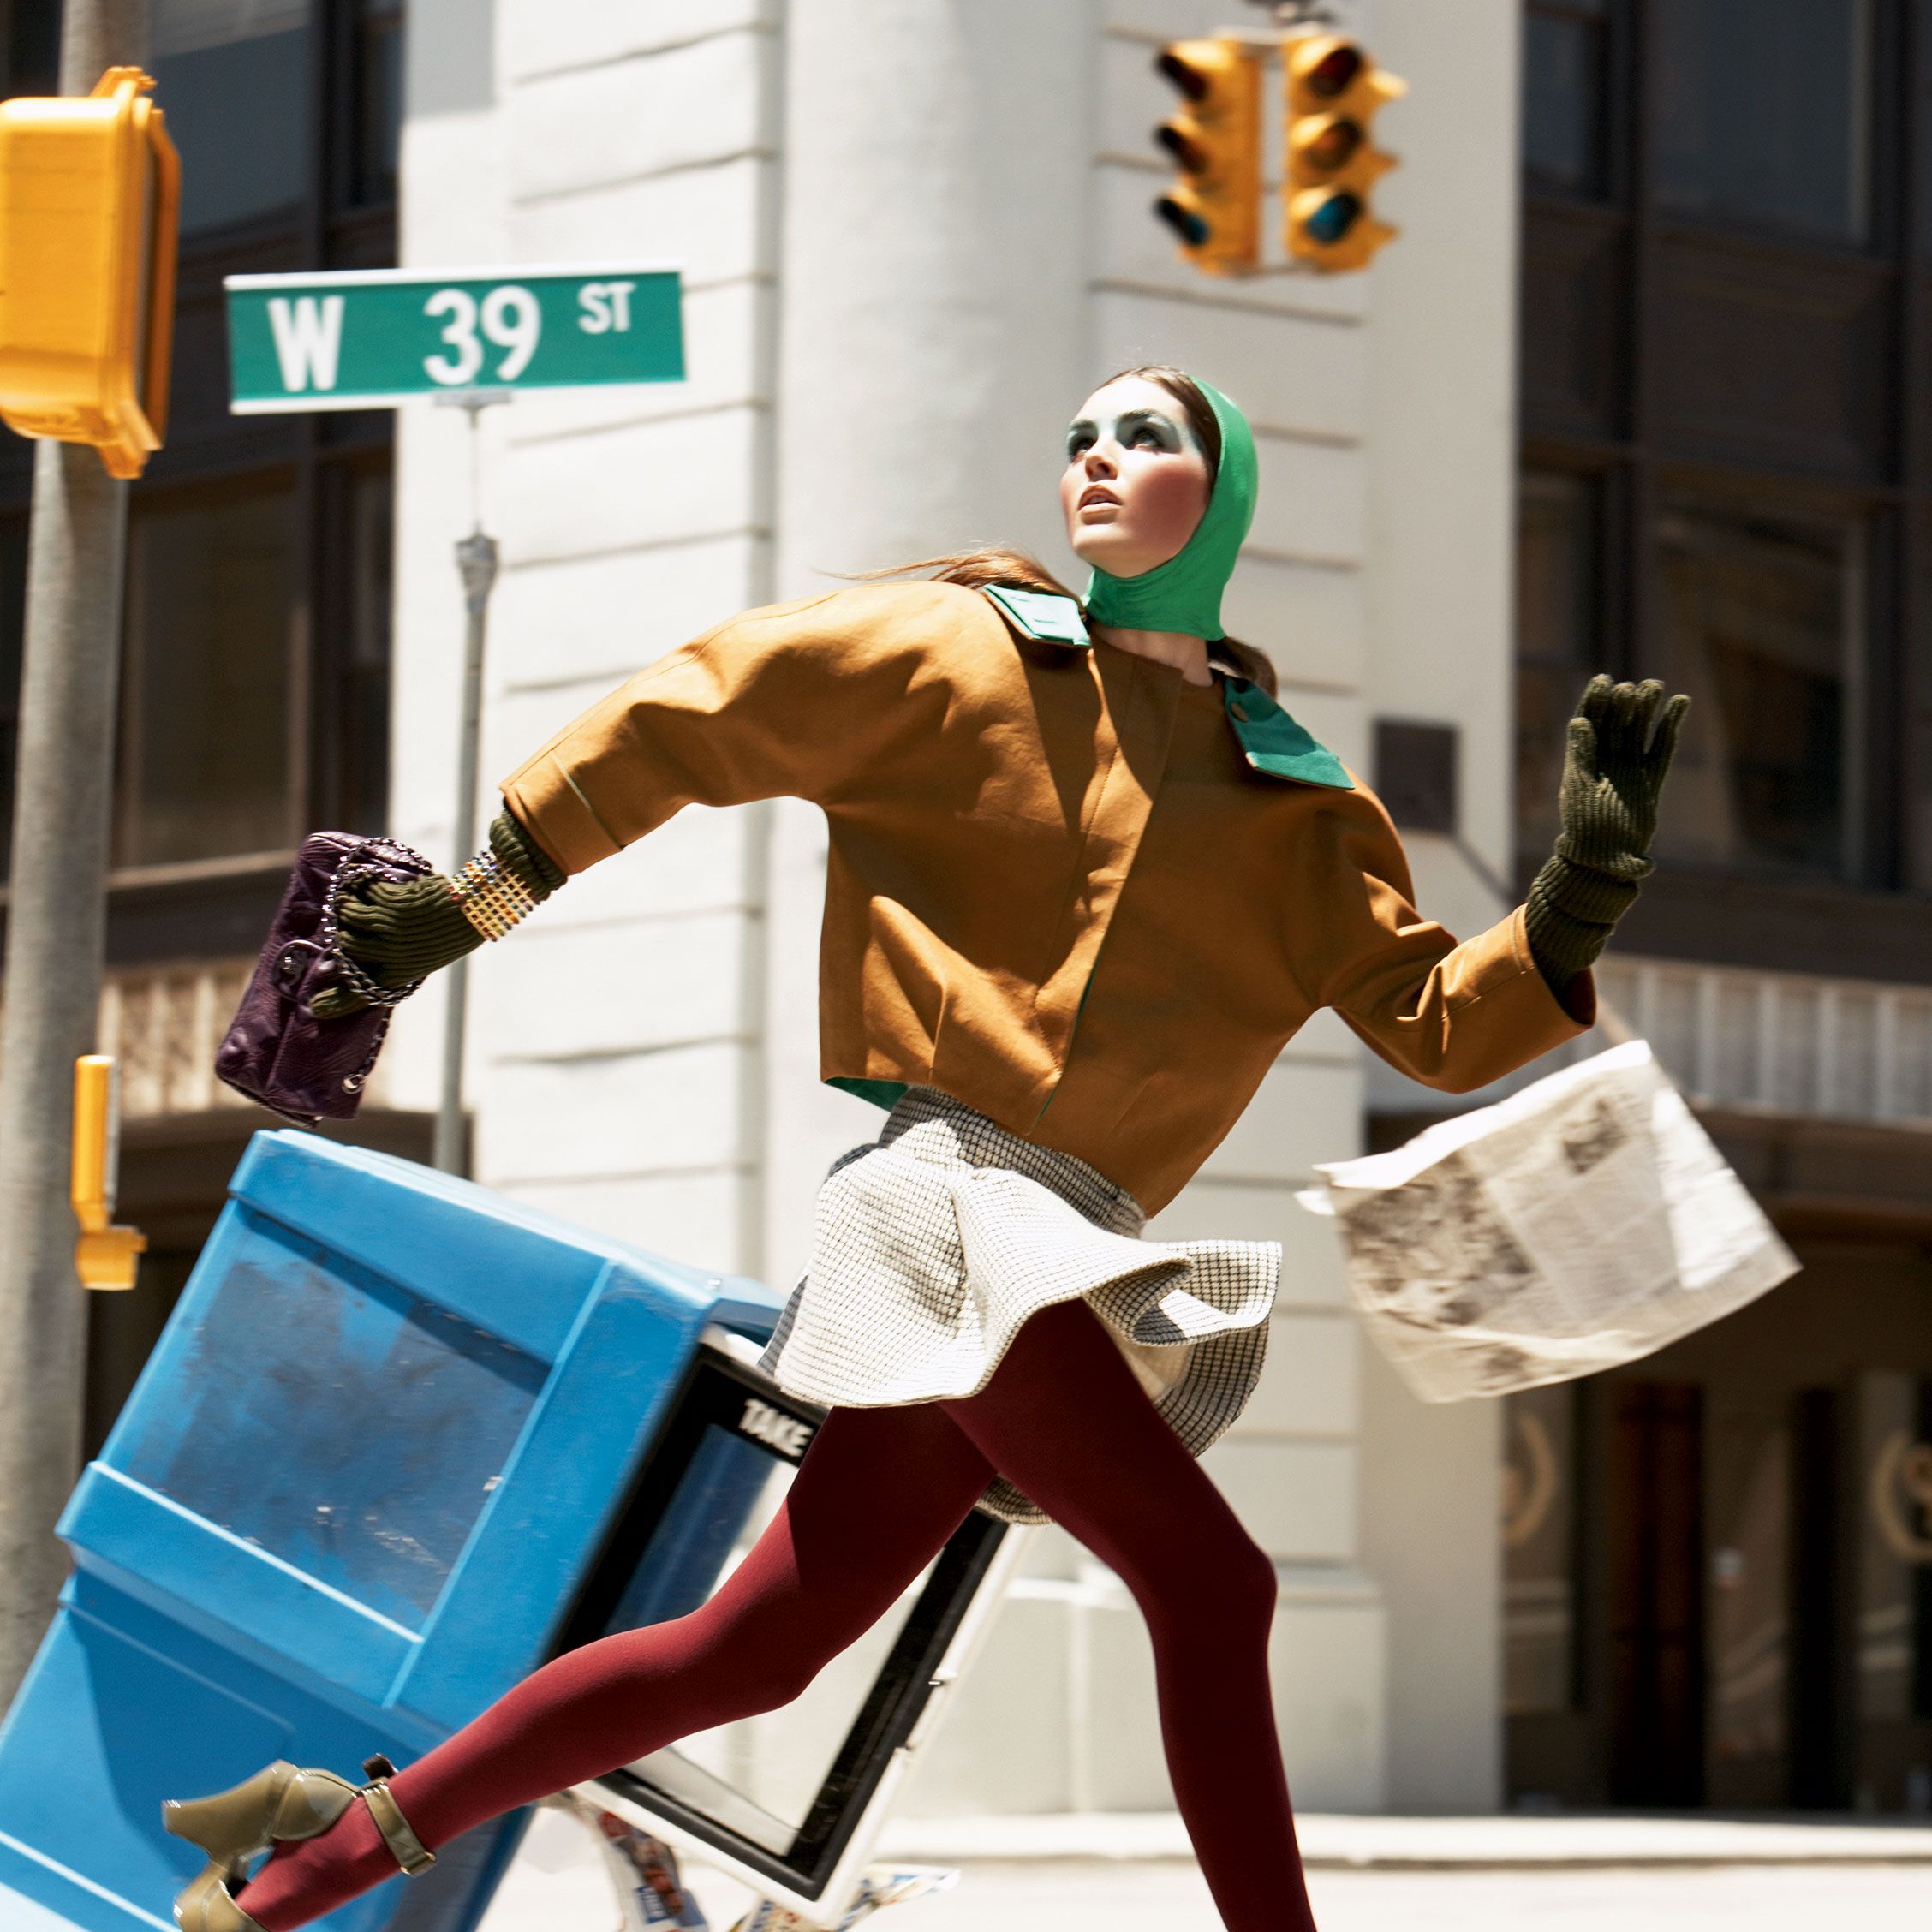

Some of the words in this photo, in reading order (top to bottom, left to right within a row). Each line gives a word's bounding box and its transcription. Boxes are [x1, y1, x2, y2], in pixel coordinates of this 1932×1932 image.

[267, 295, 344, 392] W
[423, 285, 541, 385] 39
[577, 282, 636, 334] ST
[738, 1398, 814, 1457] TAKE
